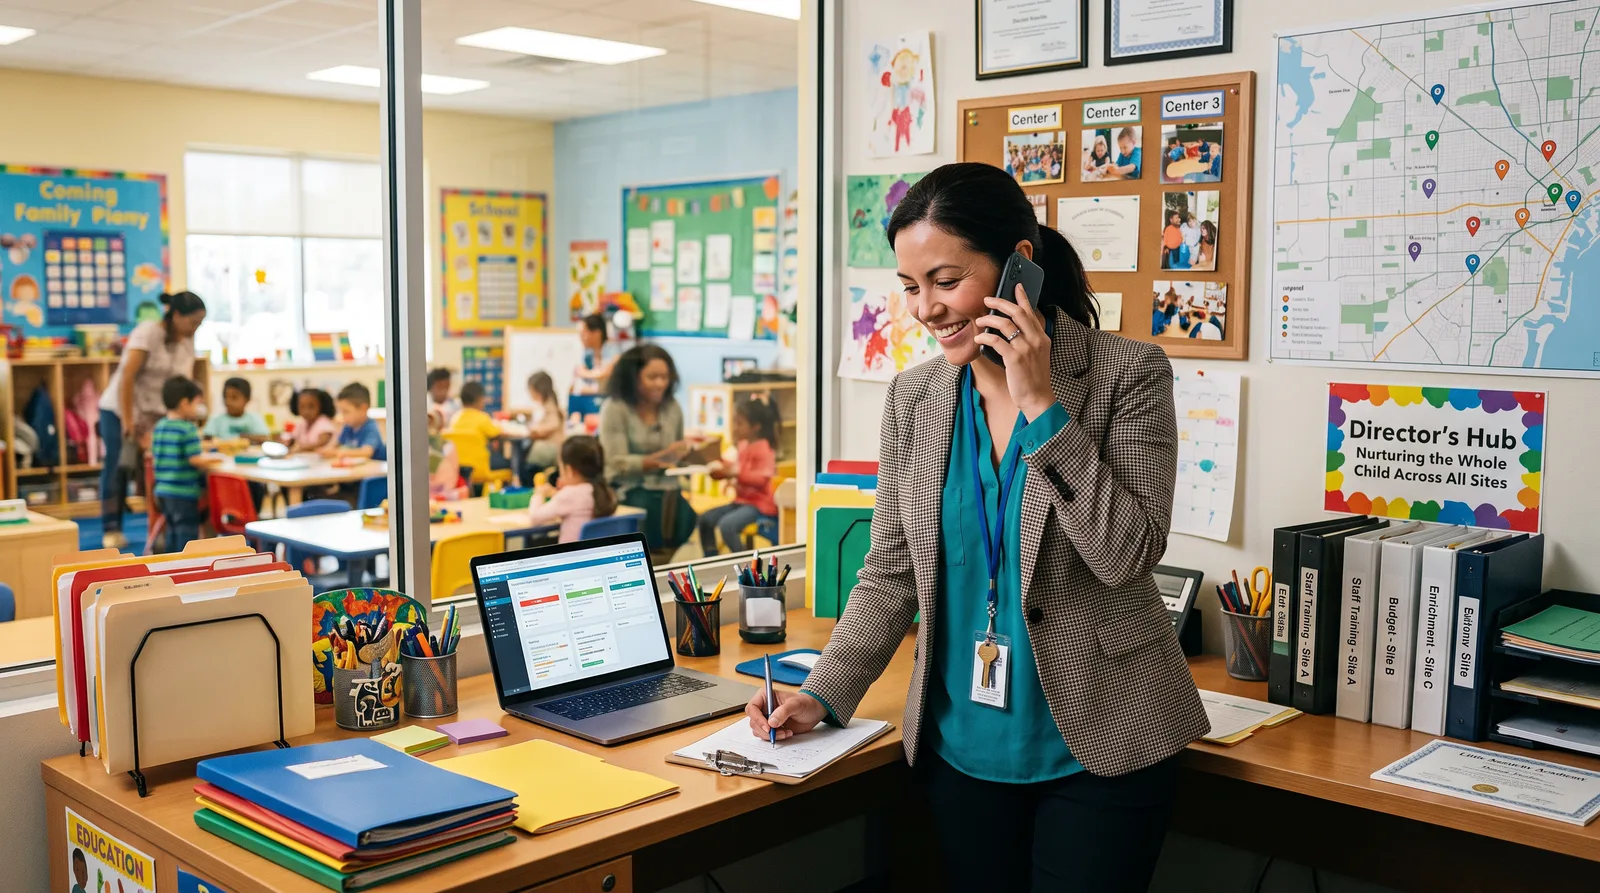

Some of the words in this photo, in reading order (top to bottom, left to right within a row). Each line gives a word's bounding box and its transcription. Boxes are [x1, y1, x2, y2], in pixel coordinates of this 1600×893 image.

[1086, 106, 1127, 119] Center
[1129, 104, 1137, 116] 2
[1165, 99, 1210, 113] Center
[1212, 97, 1220, 109] 3
[1012, 114, 1049, 126] Center
[1052, 112, 1058, 123] 1
[39, 180, 118, 207] Coming
[15, 203, 81, 228] Family
[1350, 420, 1459, 446] Director's
[1467, 427, 1517, 450] Hub
[1356, 447, 1425, 466] Nurturing
[1429, 451, 1453, 465] the
[1458, 454, 1507, 470] Whole
[1354, 464, 1390, 479] Child
[1394, 468, 1442, 484] Across
[1446, 472, 1466, 485] All
[1470, 474, 1508, 490] Sites
[1305, 572, 1314, 596] Staff
[1352, 577, 1361, 603] Staff
[1300, 599, 1313, 639] Training
[1347, 606, 1360, 646] Training
[1385, 597, 1399, 635] Budget
[1426, 585, 1439, 647] Enrichment
[1301, 648, 1311, 667] Site
[1347, 655, 1357, 675] Site
[1385, 645, 1396, 664] Site
[1301, 669, 1309, 677] A
[1385, 667, 1395, 675] B
[1424, 657, 1435, 677] Site
[1347, 677, 1356, 685] A
[1423, 680, 1433, 689] C
[76, 822, 144, 883] EDUCATION
